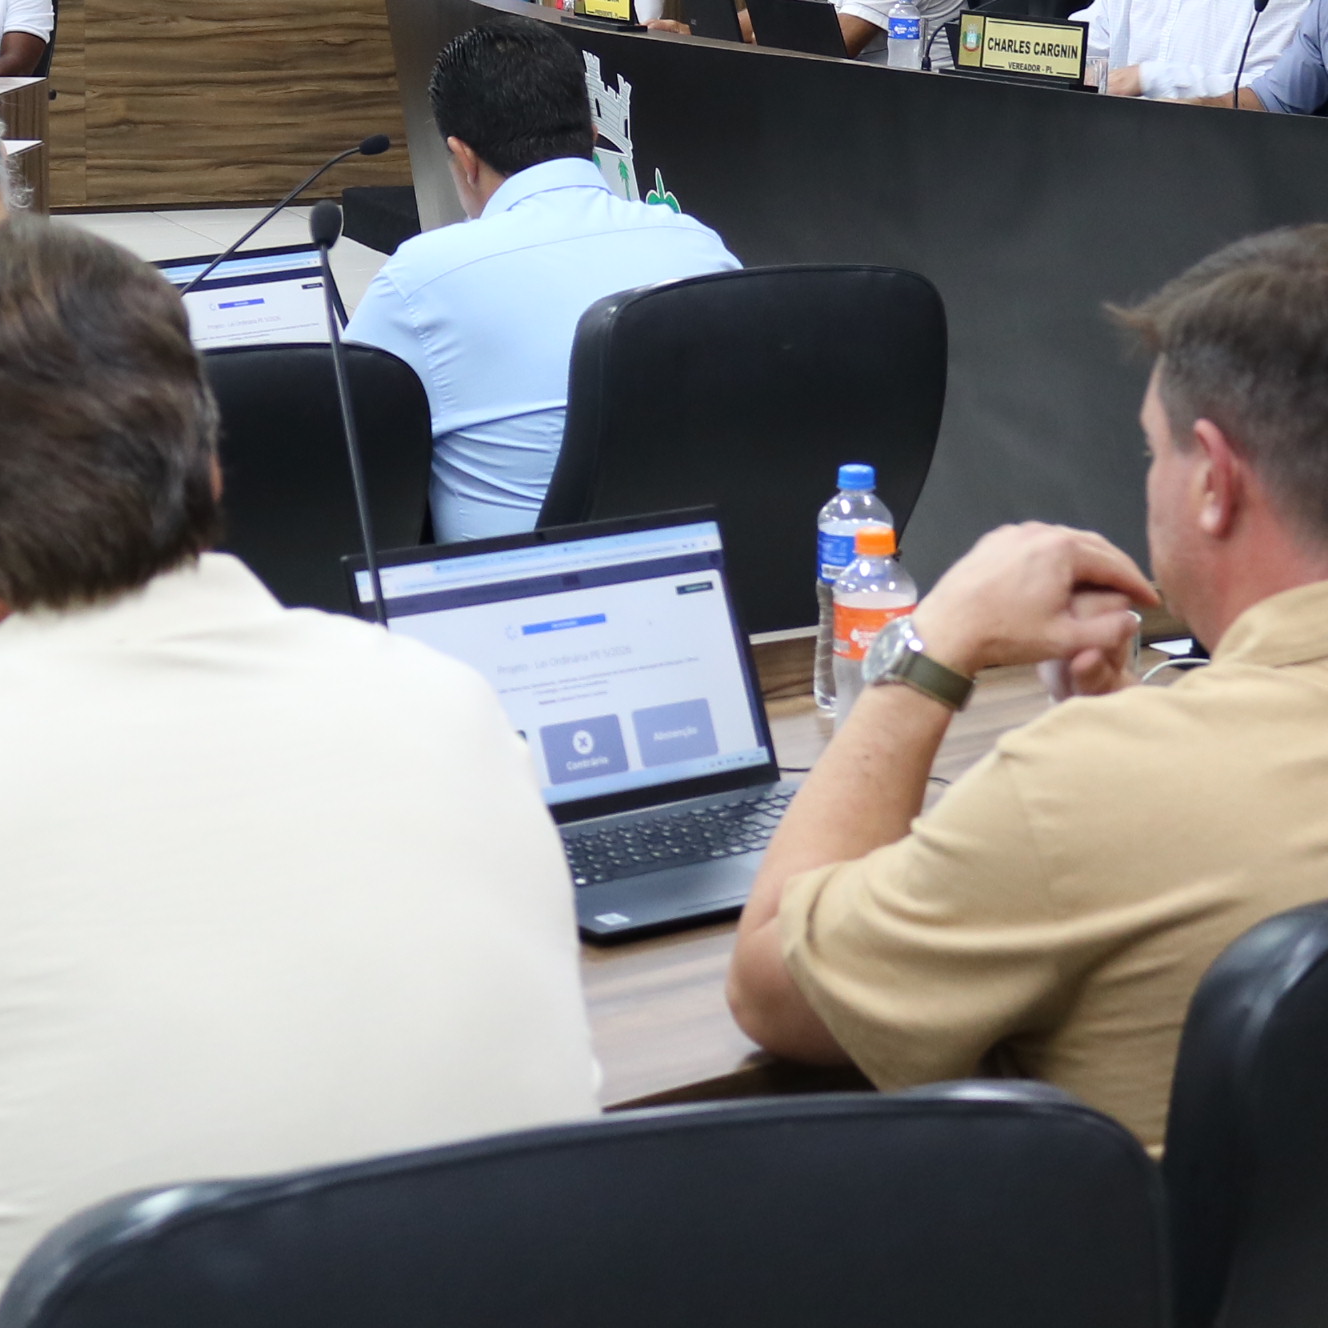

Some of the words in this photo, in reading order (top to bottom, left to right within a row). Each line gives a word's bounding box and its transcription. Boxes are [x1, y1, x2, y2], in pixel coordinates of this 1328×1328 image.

[987, 37, 1031, 55] CHARLES
[1033, 42, 1078, 60] CARGNIN
[1008, 61, 1040, 73] VEREADOR
[1046, 65, 1054, 74] PL
[567, 755, 609, 771] Contrário
